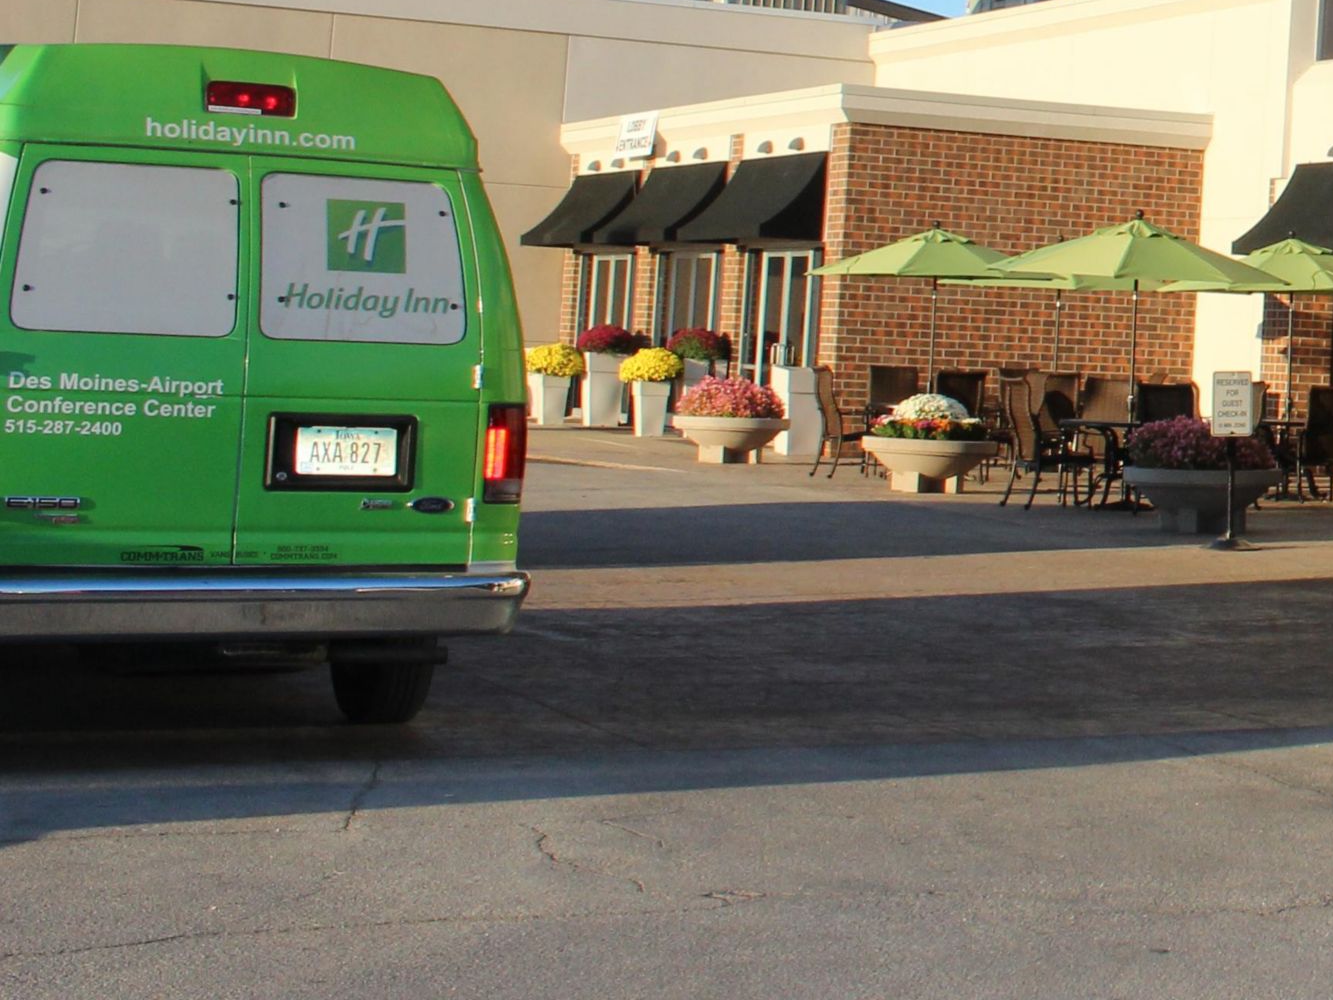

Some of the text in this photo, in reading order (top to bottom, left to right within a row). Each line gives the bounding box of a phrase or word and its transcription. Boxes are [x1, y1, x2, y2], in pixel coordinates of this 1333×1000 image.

[146, 117, 356, 150] holidayinn.com
[284, 282, 450, 319] Holiday Inn
[8, 371, 224, 397] Des Moines-Airport
[6, 395, 217, 418] Conference Center
[4, 419, 123, 436] 515-287-2400
[310, 441, 382, 464] AXA 827
